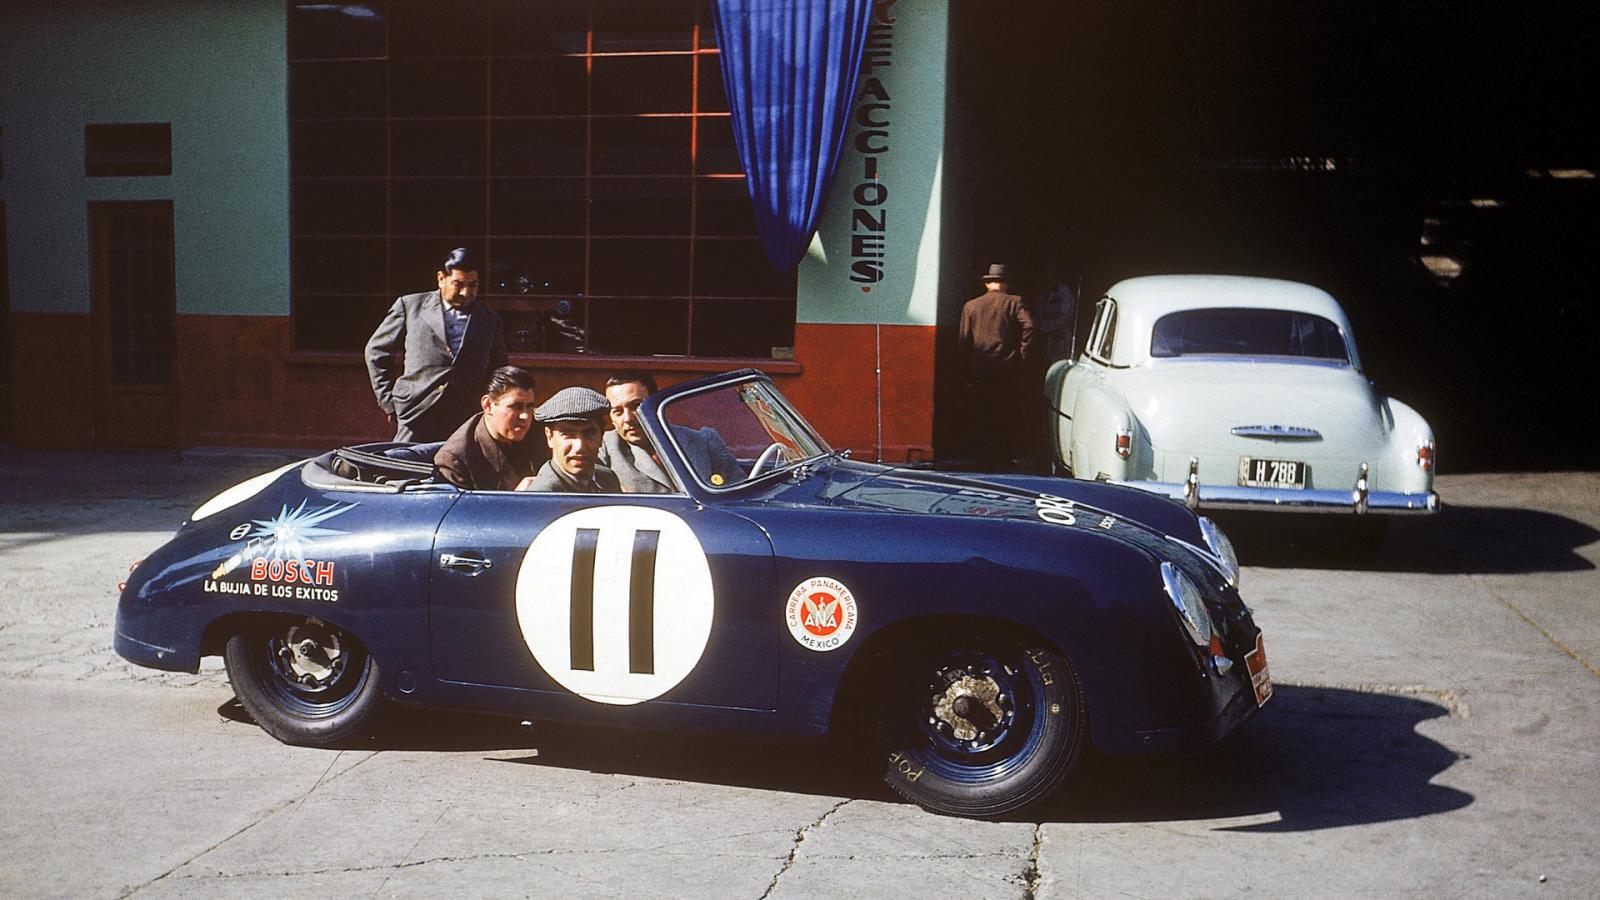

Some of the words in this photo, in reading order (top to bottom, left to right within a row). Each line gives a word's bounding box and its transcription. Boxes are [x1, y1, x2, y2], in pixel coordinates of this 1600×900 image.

[1256, 461, 1266, 482] H
[251, 557, 334, 586] BOSCH
[204, 580, 219, 593] LA
[219, 581, 251, 596] BUJIA
[254, 583, 269, 597] DE
[272, 585, 293, 598] LOS
[296, 587, 339, 602] EXITOS
[568, 528, 660, 675] 11
[790, 587, 807, 628] CARRERA
[811, 580, 855, 629] PANAMERICANA
[804, 612, 838, 628] ANA
[803, 635, 839, 647] MEXICO
